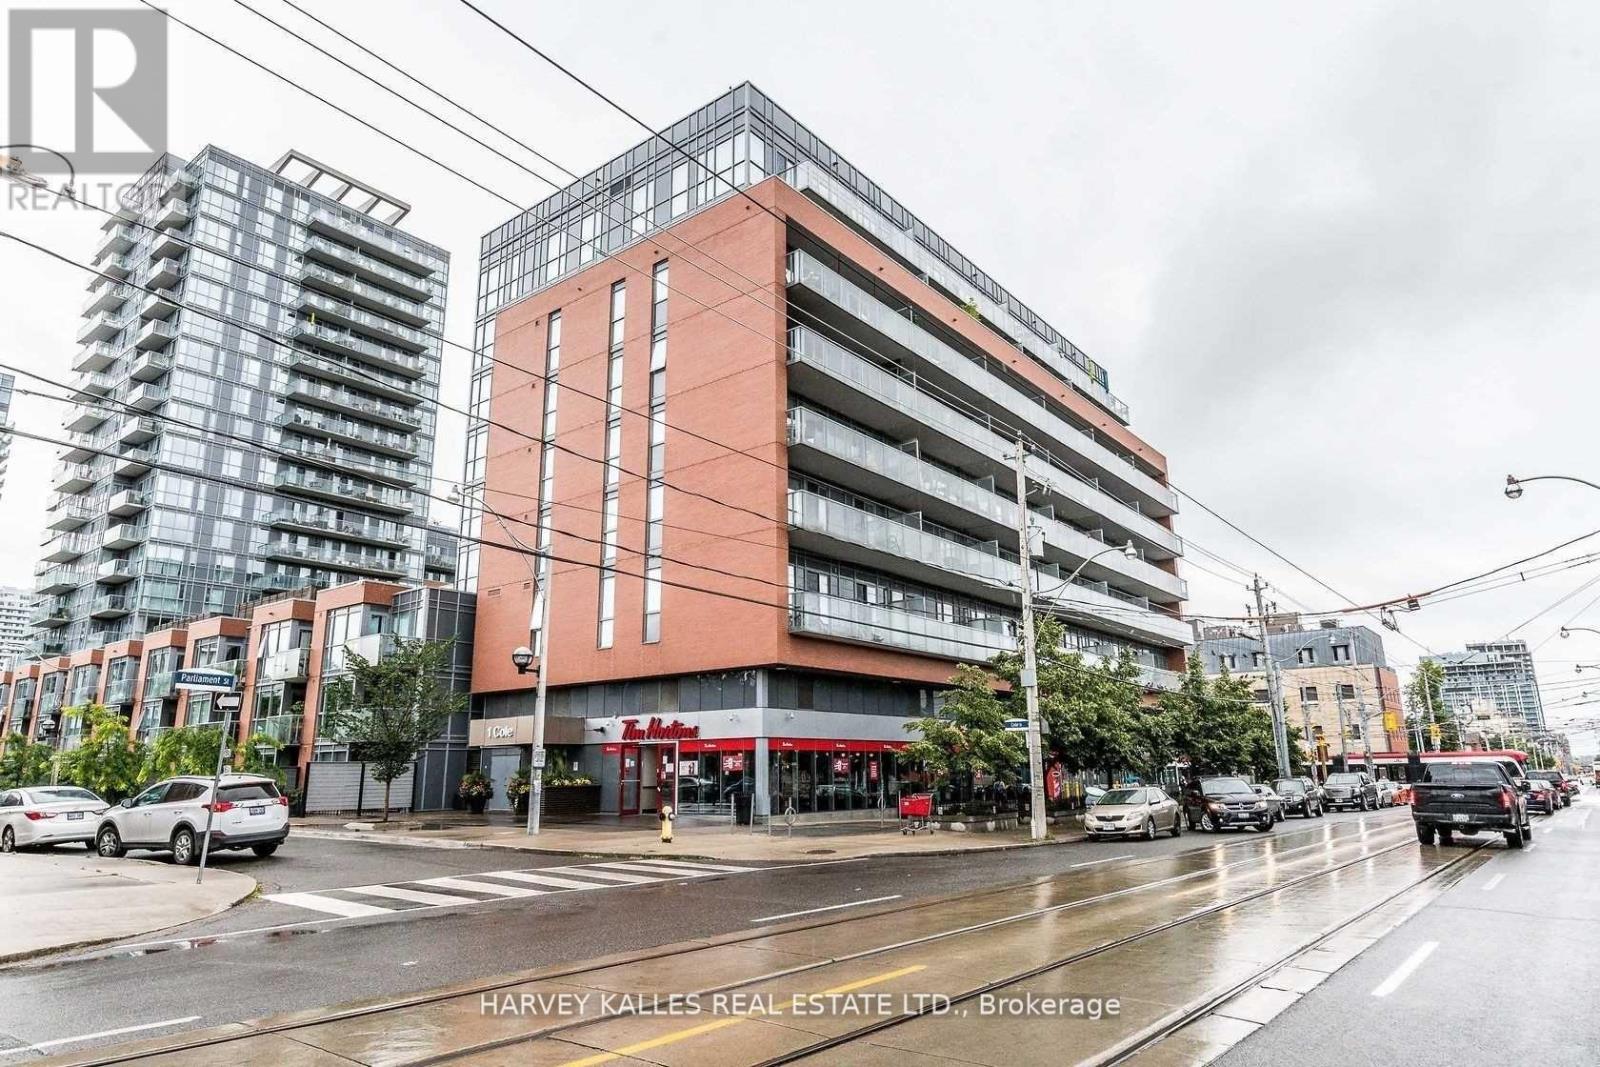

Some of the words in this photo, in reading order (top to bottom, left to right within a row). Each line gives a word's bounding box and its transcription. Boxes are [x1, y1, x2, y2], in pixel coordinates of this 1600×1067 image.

[181, 673, 220, 684] Parliament
[492, 725, 514, 738] Cole
[621, 719, 646, 740] Tim
[646, 717, 699, 739] Hortons
